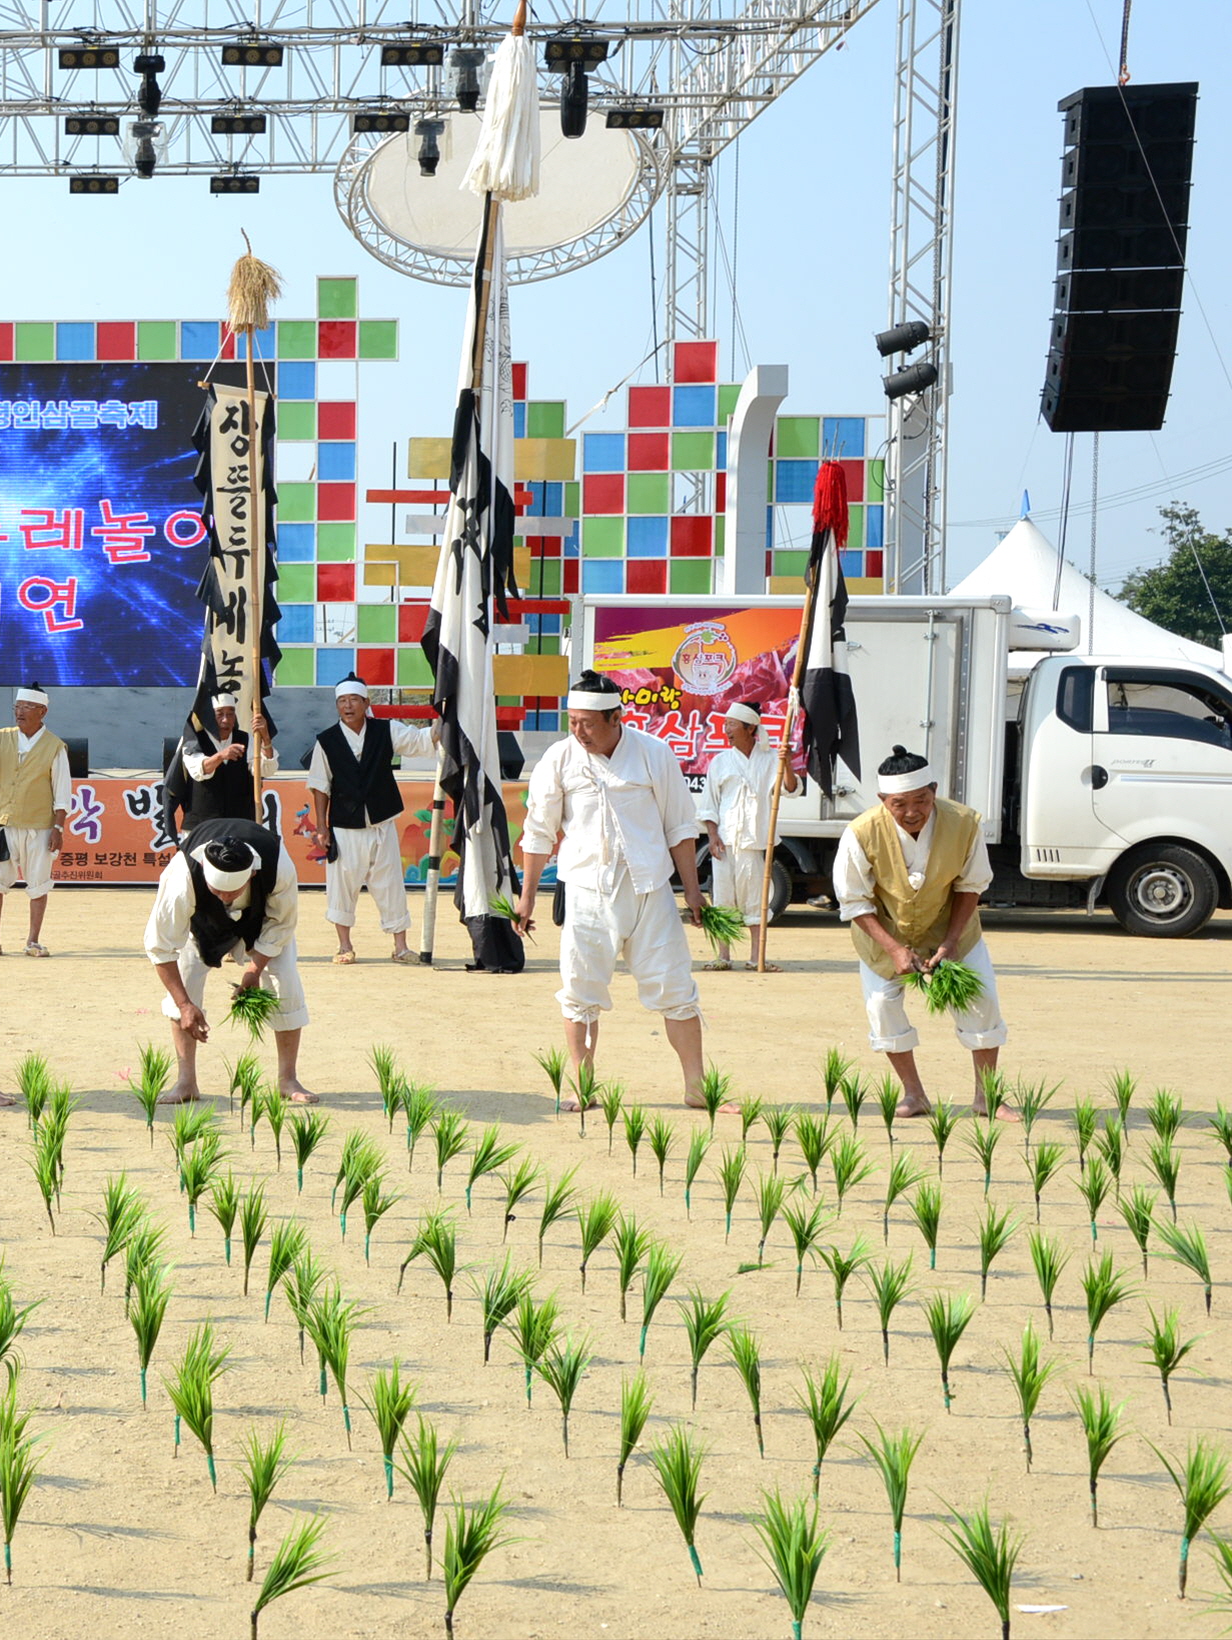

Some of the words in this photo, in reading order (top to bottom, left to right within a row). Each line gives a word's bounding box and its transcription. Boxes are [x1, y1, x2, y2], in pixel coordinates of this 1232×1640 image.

[59, 852, 87, 867] 증평
[94, 852, 137, 867] 보강천
[143, 852, 171, 867] 특설
